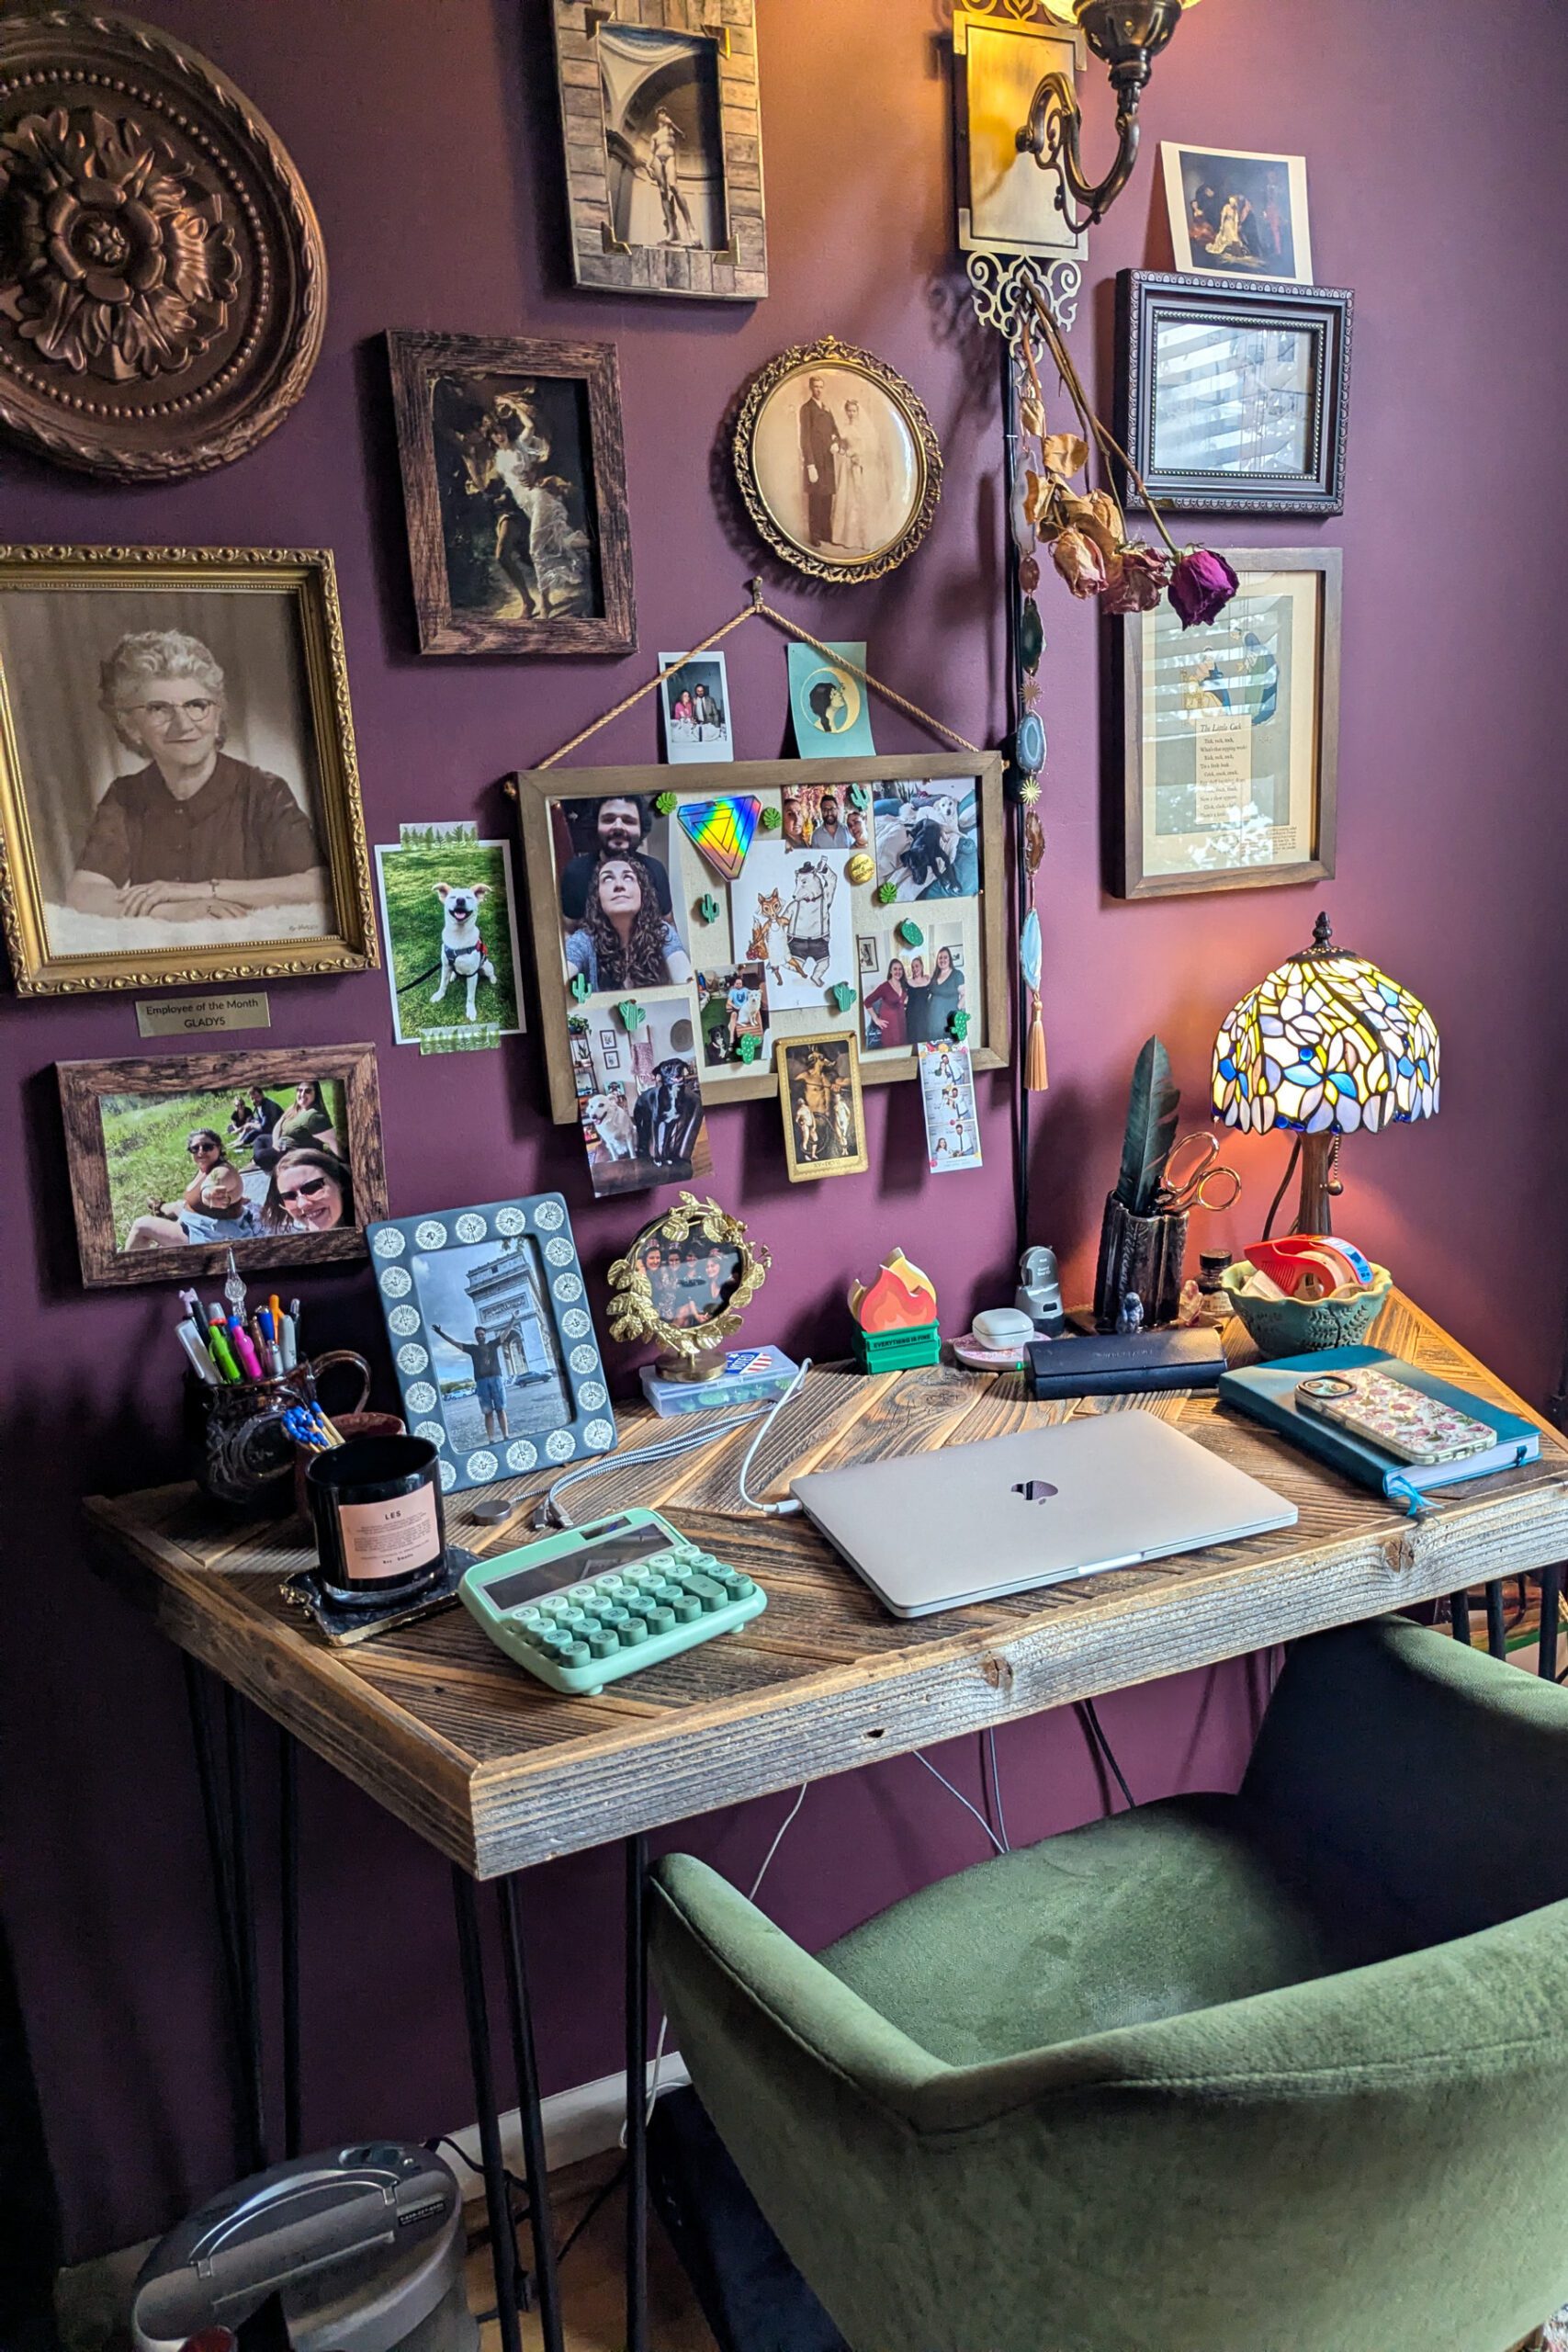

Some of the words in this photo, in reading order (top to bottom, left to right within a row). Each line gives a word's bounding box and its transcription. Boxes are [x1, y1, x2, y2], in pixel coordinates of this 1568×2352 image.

[146, 1003, 194, 1016] Employee
[196, 1001, 206, 1011] of
[209, 1001, 224, 1010] the
[227, 999, 258, 1009] Month
[184, 1016, 226, 1028] GLADYS
[874, 1338, 910, 1348] EVERYTHING
[728, 1353, 755, 1370] VOTED
[385, 1510, 401, 1521] LES
